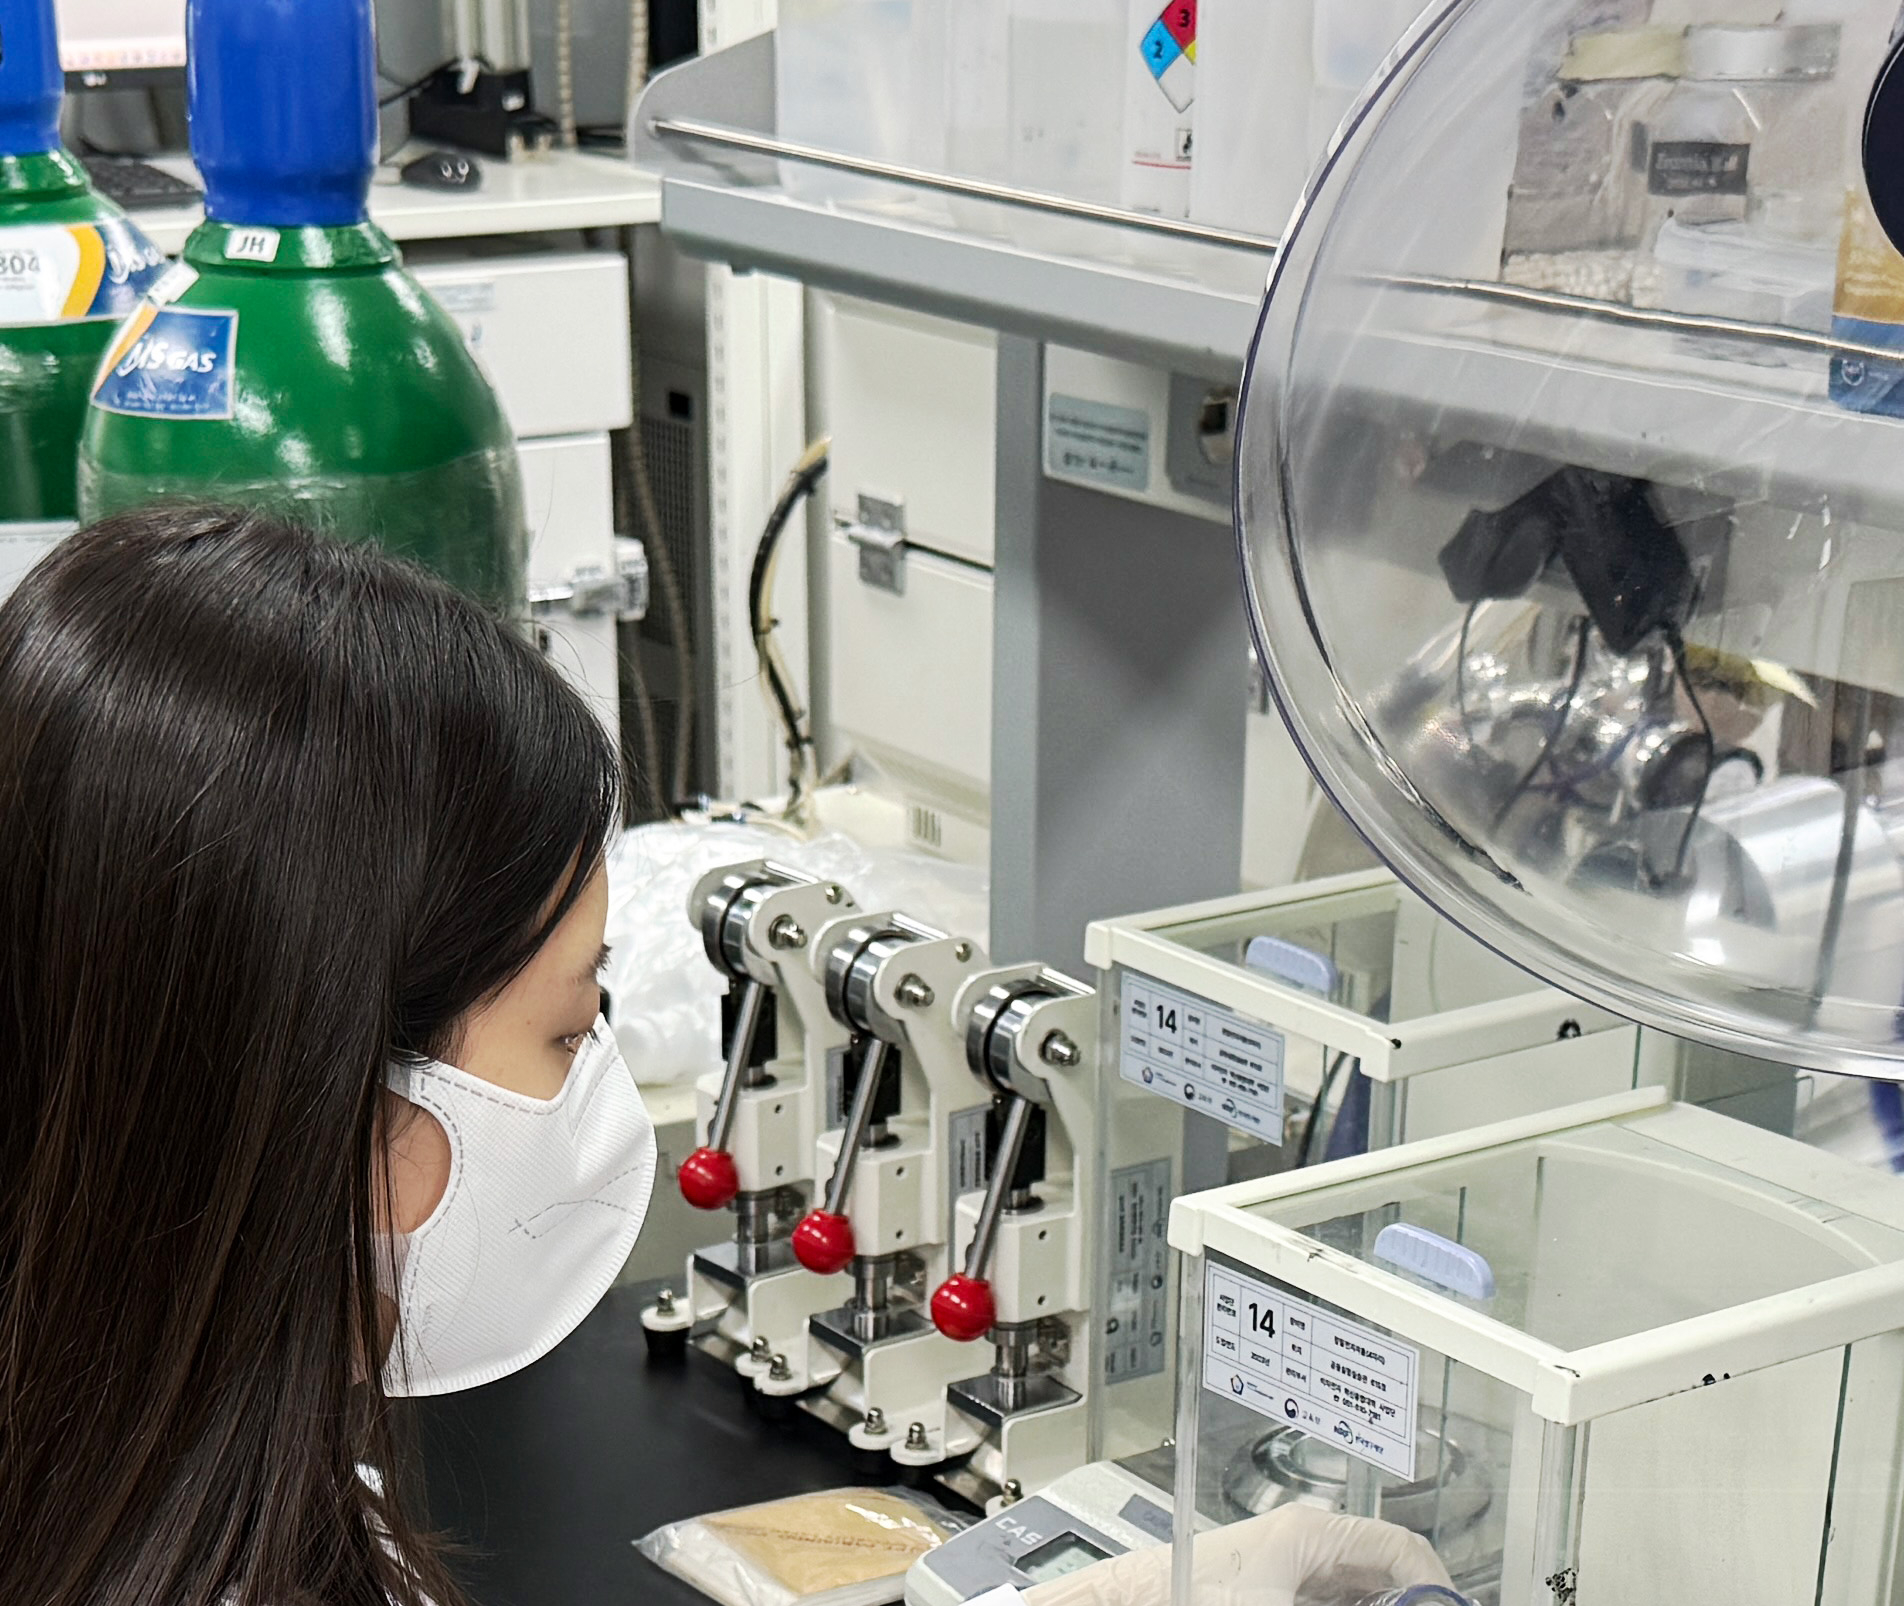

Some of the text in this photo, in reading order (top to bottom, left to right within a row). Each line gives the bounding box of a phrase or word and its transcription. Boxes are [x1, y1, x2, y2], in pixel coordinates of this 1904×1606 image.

[1179, 8, 1190, 27] 3
[1153, 40, 1163, 58] 2
[236, 235, 265, 253] JH
[1156, 1004, 1177, 1034] 14
[1248, 1301, 1275, 1338] 14
[995, 1516, 1043, 1545] CAS
